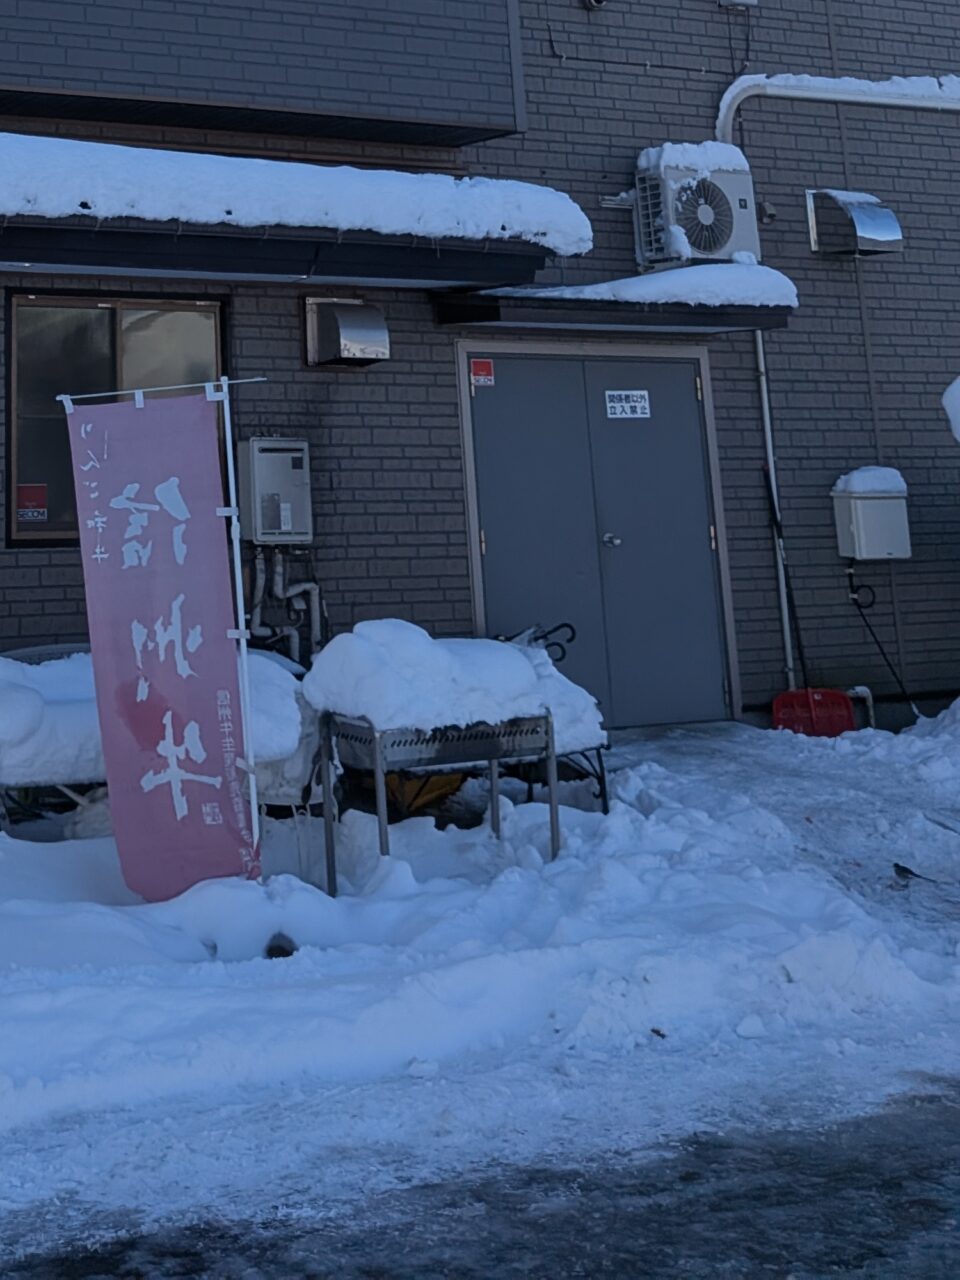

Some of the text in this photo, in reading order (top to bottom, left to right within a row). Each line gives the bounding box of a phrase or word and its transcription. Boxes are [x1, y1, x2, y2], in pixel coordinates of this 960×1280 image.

[607, 393, 647, 404] 関係者以外
[609, 404, 648, 415] 立入禁止
[16, 509, 46, 519] SECOM
